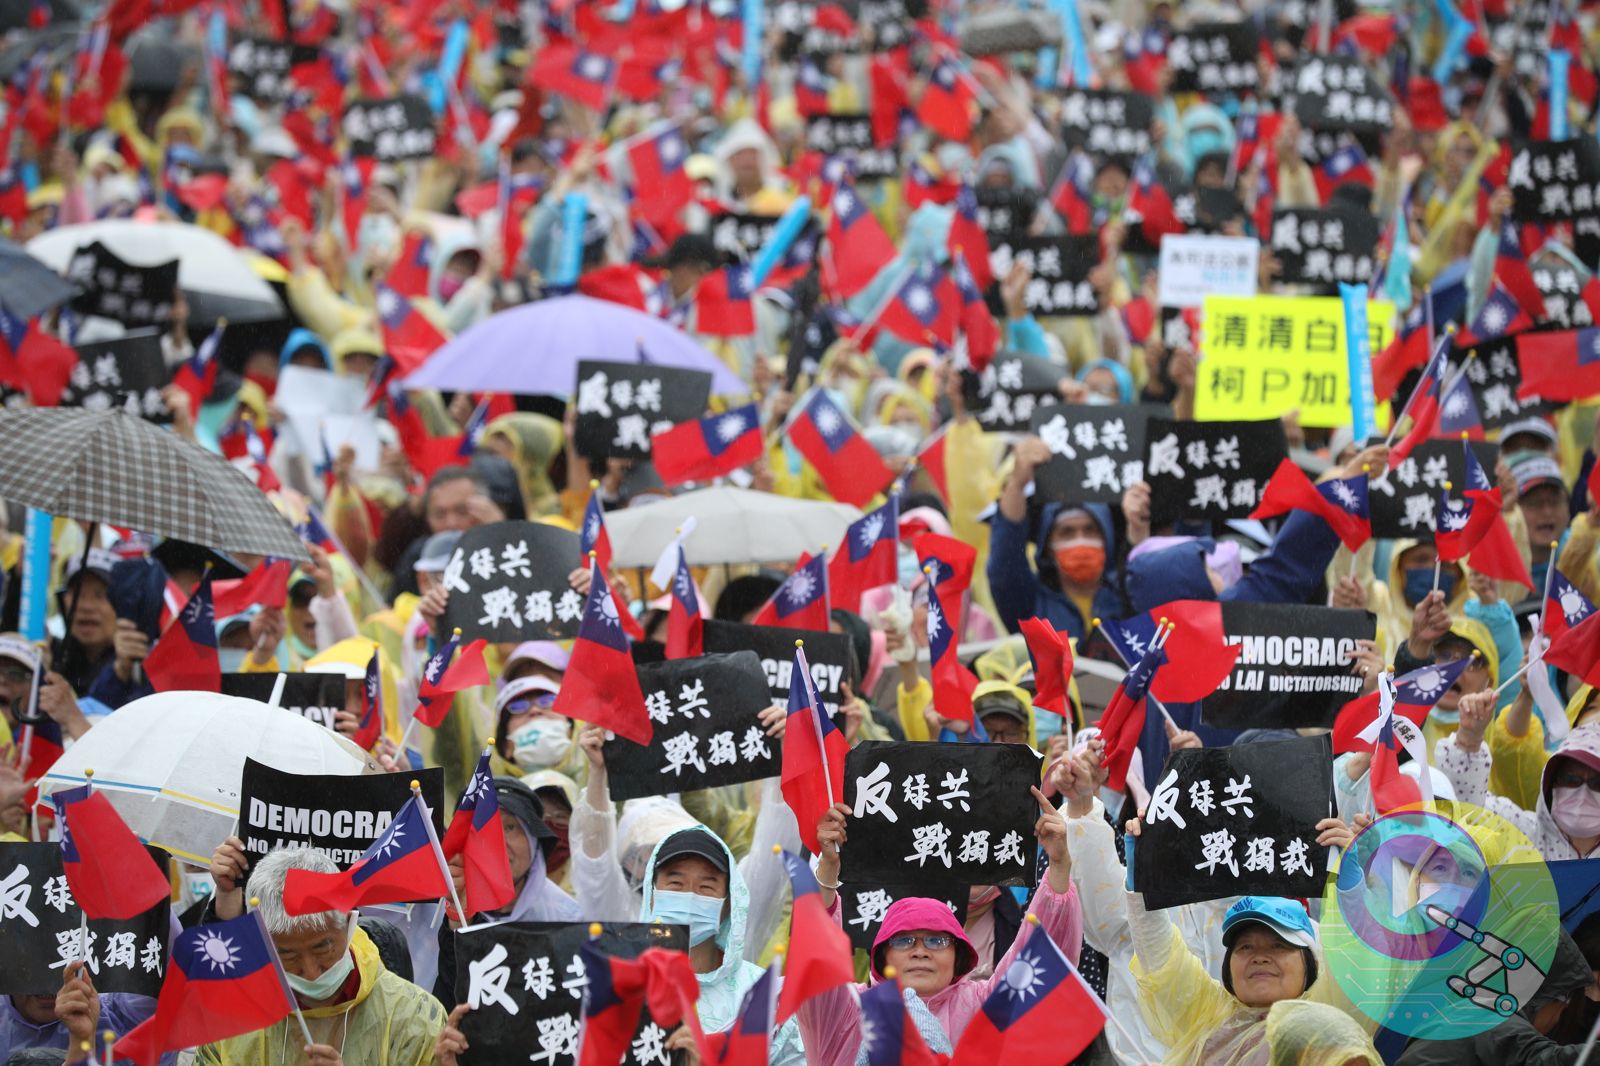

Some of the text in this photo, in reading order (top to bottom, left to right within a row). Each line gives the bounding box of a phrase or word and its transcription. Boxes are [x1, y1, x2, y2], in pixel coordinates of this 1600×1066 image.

[1211, 367, 1350, 405] 柯P加
[1038, 414, 1128, 460] 反綠共
[1149, 433, 1240, 480] 反綠共
[1190, 474, 1266, 512] 戰獨
[478, 586, 583, 629] 戰獨裁
[644, 678, 711, 725] 綠共
[1234, 669, 1265, 691] LAI
[1268, 675, 1364, 693] DICTATORSHIP
[660, 725, 772, 777] 戰獨裁
[853, 761, 971, 824] 反綠共
[1146, 768, 1254, 830] 反綠共
[247, 836, 269, 855] NO
[904, 821, 1025, 869] 戰獨裁
[1195, 827, 1315, 878] 戰獨裁
[48, 927, 163, 979] 戰獨裁
